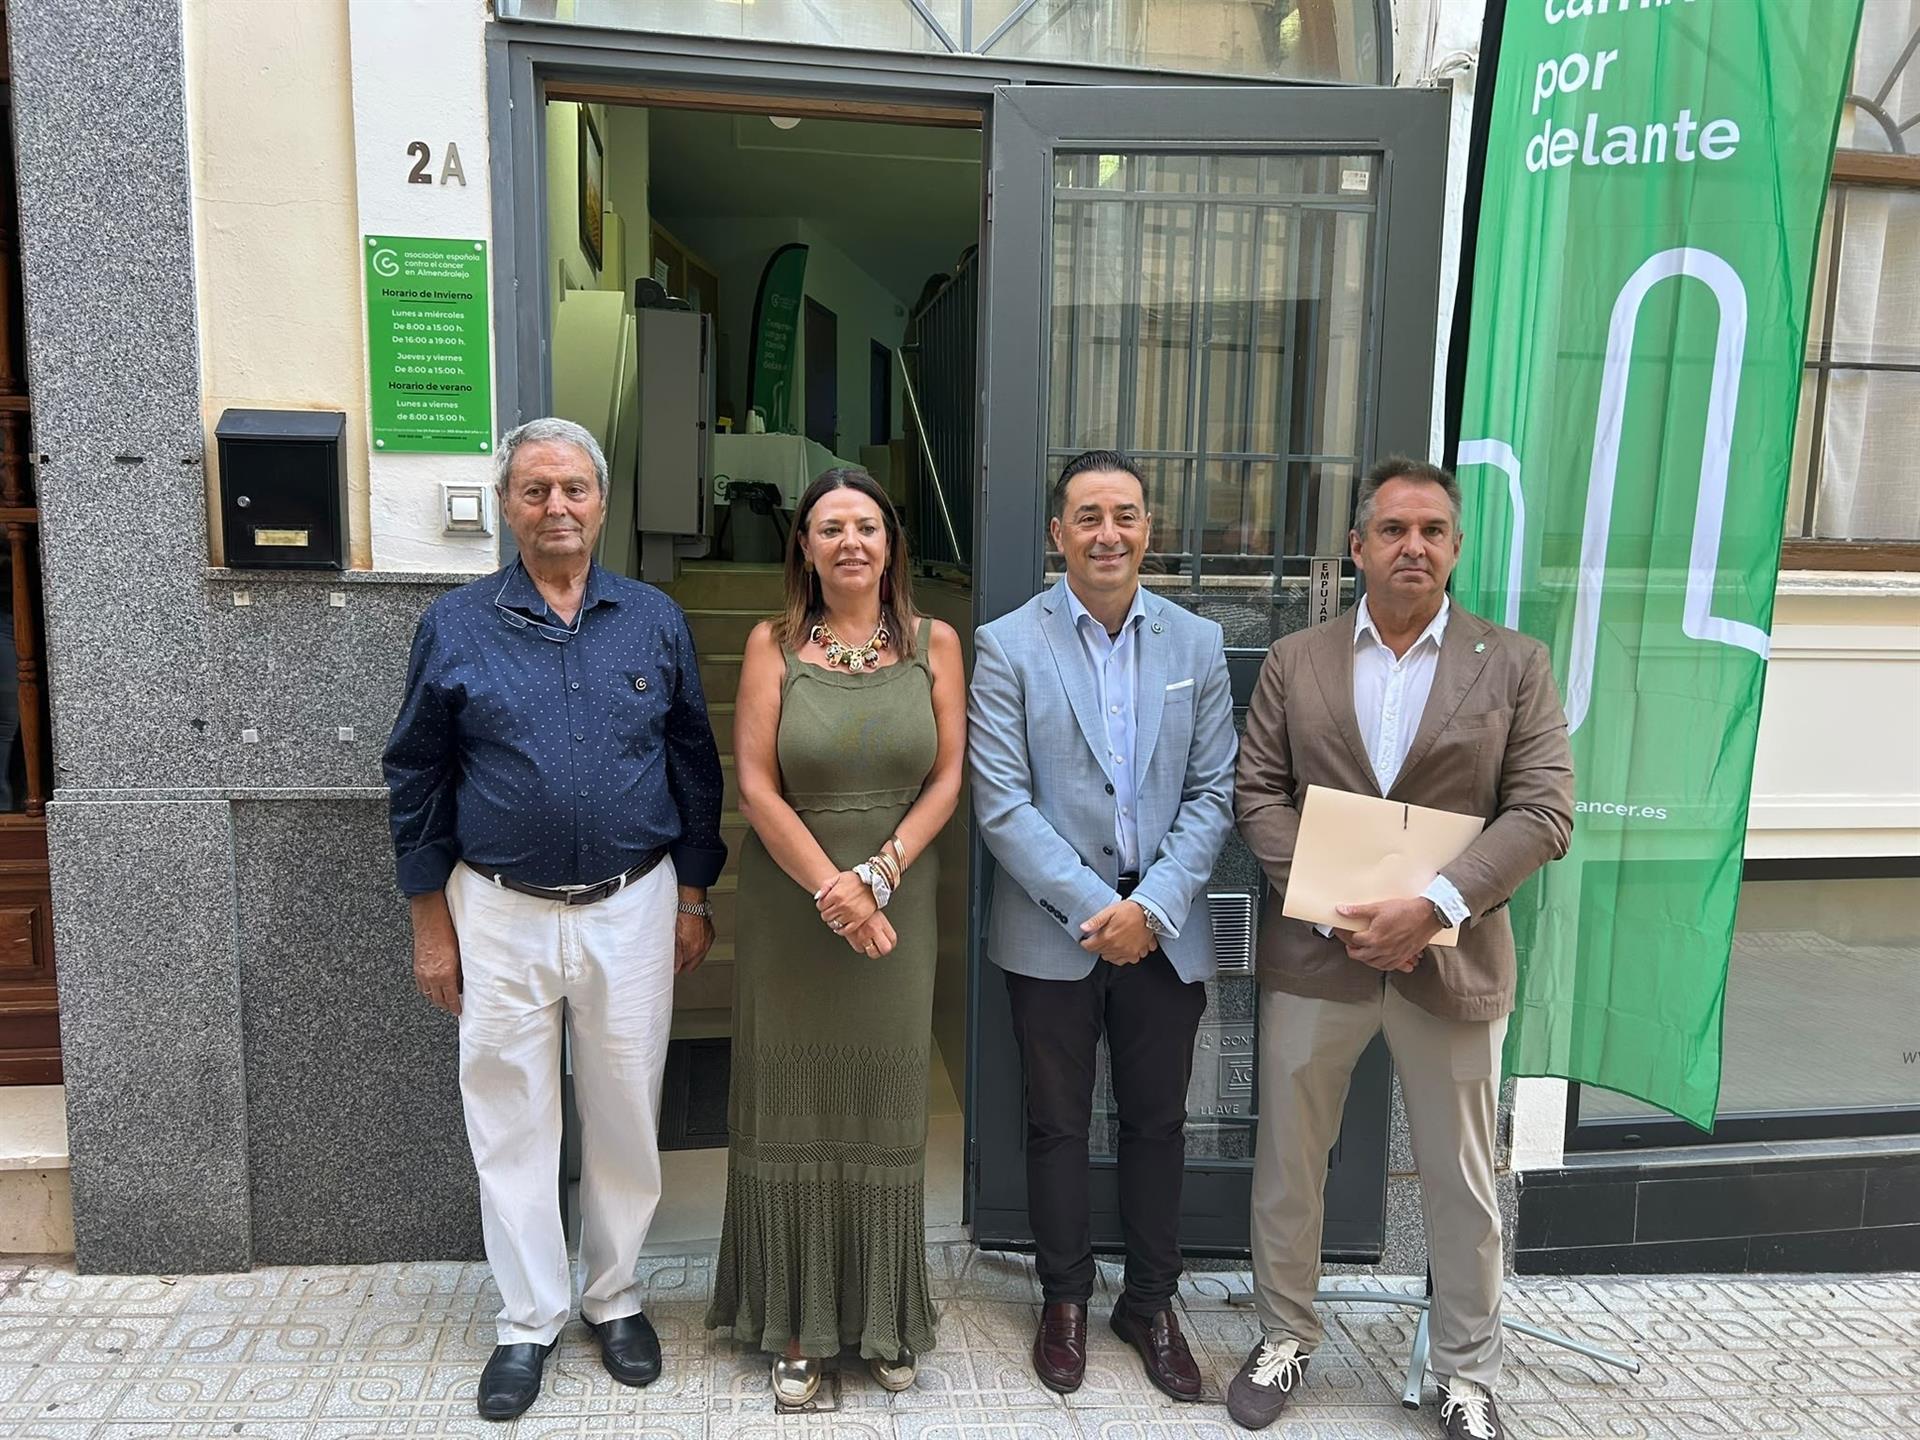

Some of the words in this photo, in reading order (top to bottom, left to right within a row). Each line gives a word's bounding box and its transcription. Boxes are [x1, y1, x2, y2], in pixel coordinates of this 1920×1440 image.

[1532, 48, 1618, 116] por
[1525, 109, 1741, 173] delante
[404, 260, 429, 268] contra
[417, 268, 470, 279] Almendralejo
[382, 288, 418, 298] Horario
[420, 289, 432, 298] de
[434, 291, 473, 300] Invierno
[391, 309, 416, 317] Lunes
[424, 310, 464, 319] miércoles
[393, 322, 405, 330] De
[433, 324, 455, 332] 15:00
[392, 335, 404, 343] De
[405, 335, 427, 344] 16:00
[435, 336, 457, 345] 19:00
[397, 353, 425, 361] Jueves
[432, 354, 463, 362] viernes
[394, 365, 406, 373] De
[407, 366, 426, 374] 8:00
[434, 367, 456, 375] 15:00
[388, 381, 425, 390] Horario
[425, 382, 438, 391] de
[439, 384, 473, 392] verano
[396, 400, 421, 408] Lunes
[429, 401, 459, 409] viernes
[396, 413, 408, 421] de
[1319, 562, 1330, 624] EMPUJAR
[1574, 800, 1668, 820] ancer.es
[1221, 1035, 1255, 1046] CON
[1200, 1104, 1240, 1115] LLAVE
